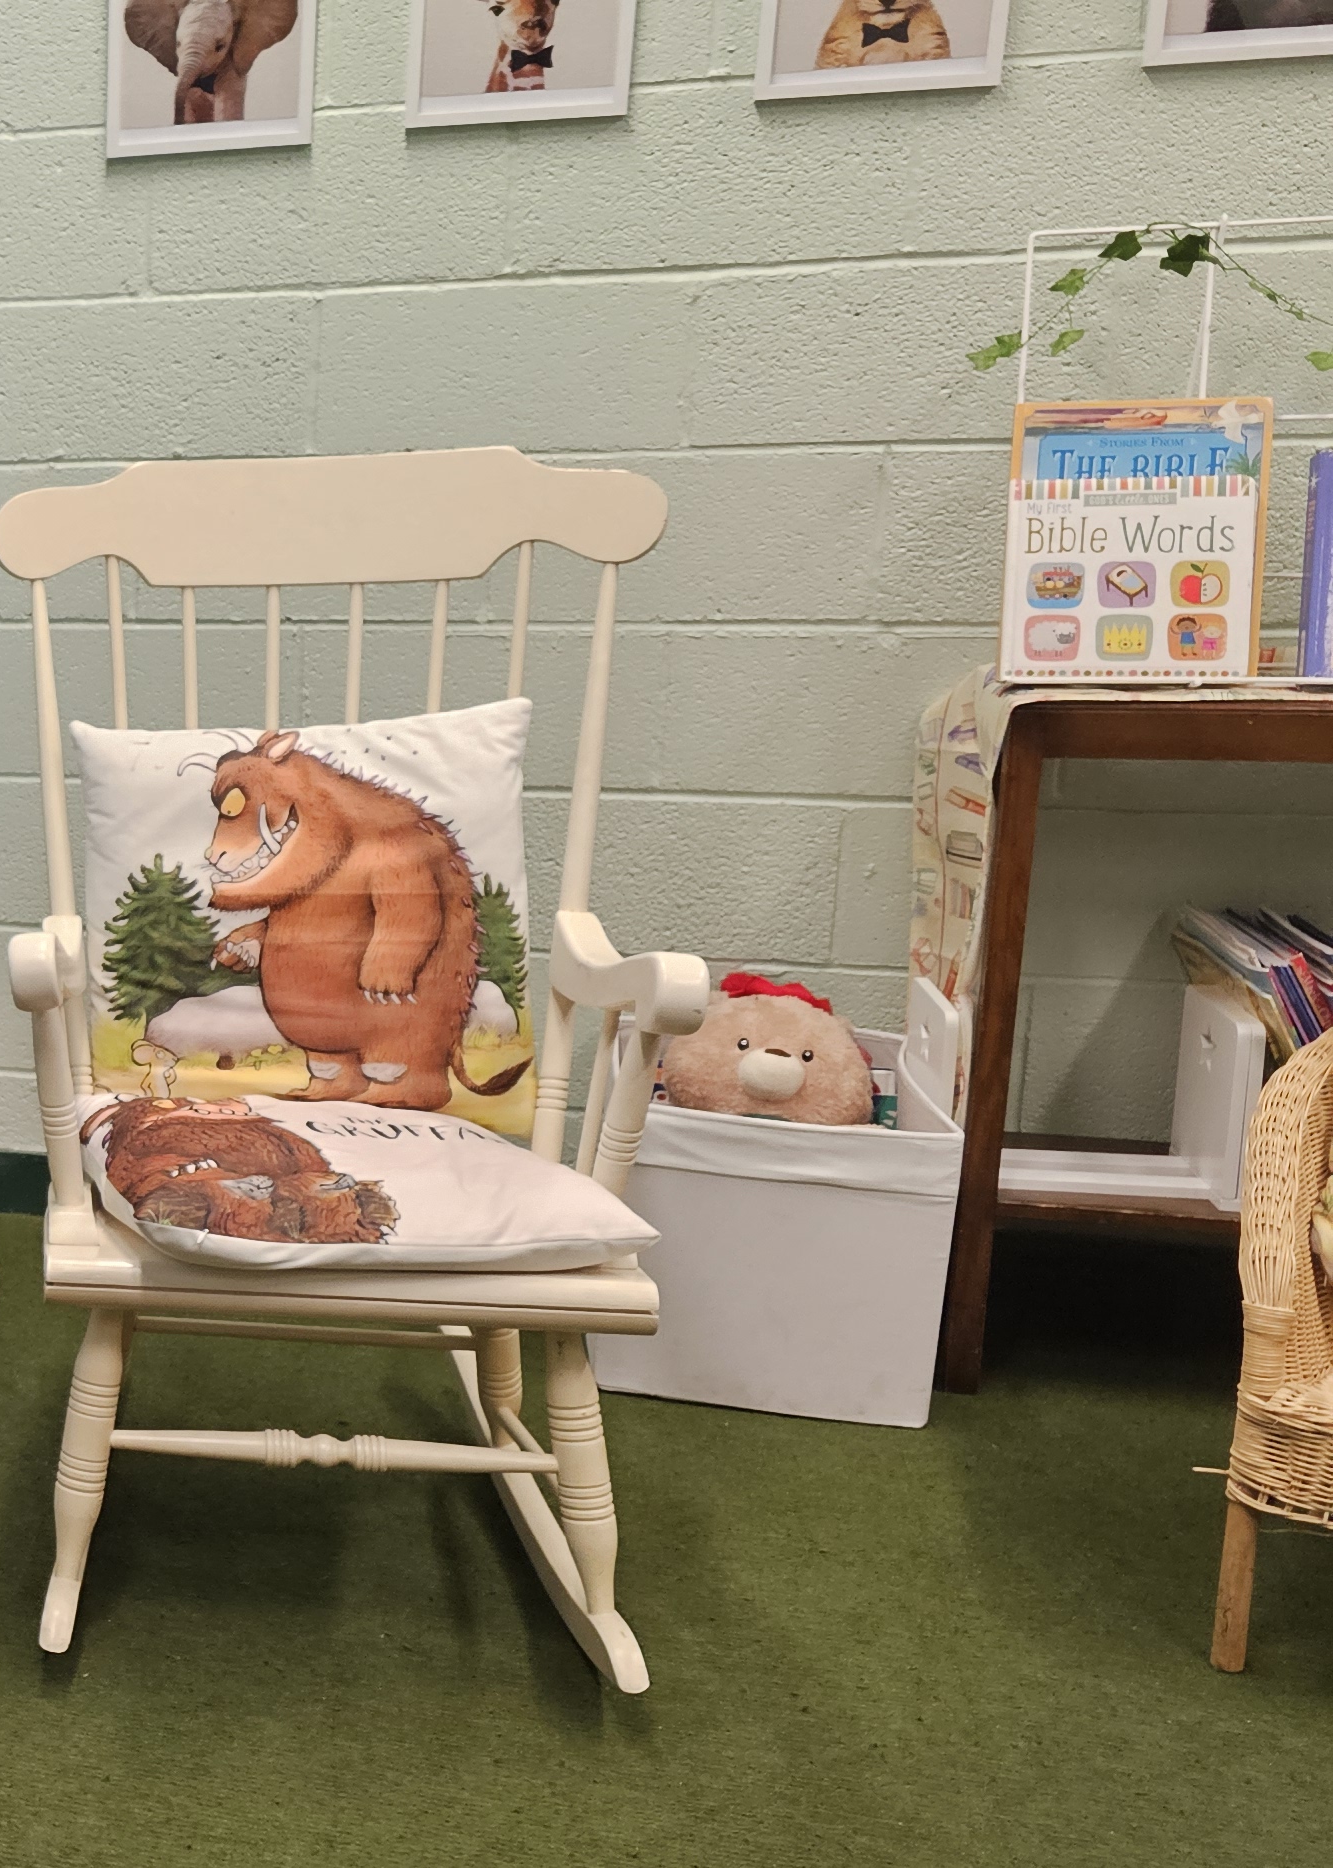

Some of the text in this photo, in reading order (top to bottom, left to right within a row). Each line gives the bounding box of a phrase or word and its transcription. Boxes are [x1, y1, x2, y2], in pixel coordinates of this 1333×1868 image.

[1052, 449, 1116, 479] THE
[1027, 502, 1073, 515] My First
[1024, 515, 1235, 554] Bible Words
[305, 1119, 507, 1146] GRUFFA
